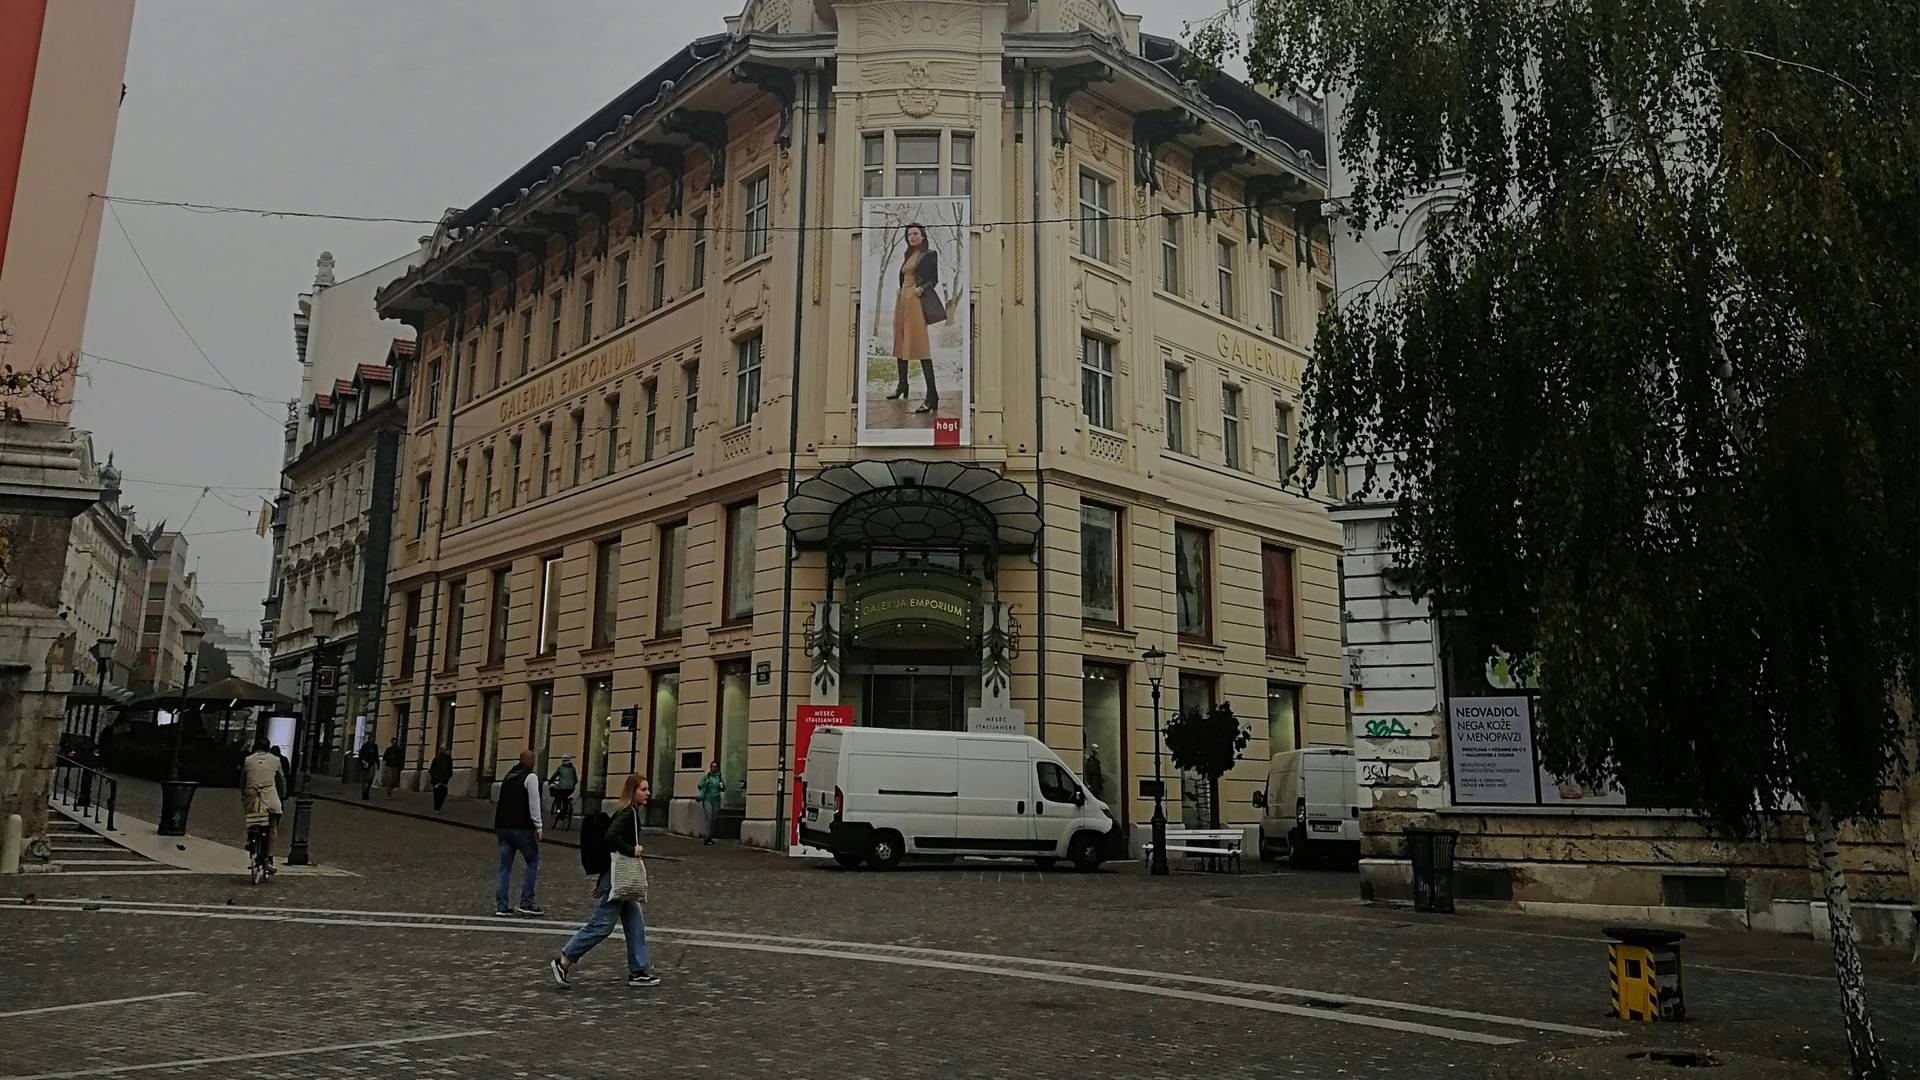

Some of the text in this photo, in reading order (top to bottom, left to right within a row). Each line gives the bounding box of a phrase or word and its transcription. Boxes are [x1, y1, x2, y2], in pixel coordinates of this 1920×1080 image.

[1216, 330, 1301, 386] GALERIJA
[500, 336, 636, 423] GALERIJA EMPORIUM
[936, 421, 958, 432] högl
[863, 598, 962, 616] GALERIJA EMPORIUM
[1456, 707, 1520, 718] NEOVADIOL
[1457, 718, 1511, 731] NEGA KOŽE
[1458, 732, 1521, 742] V MENOPAVZI
